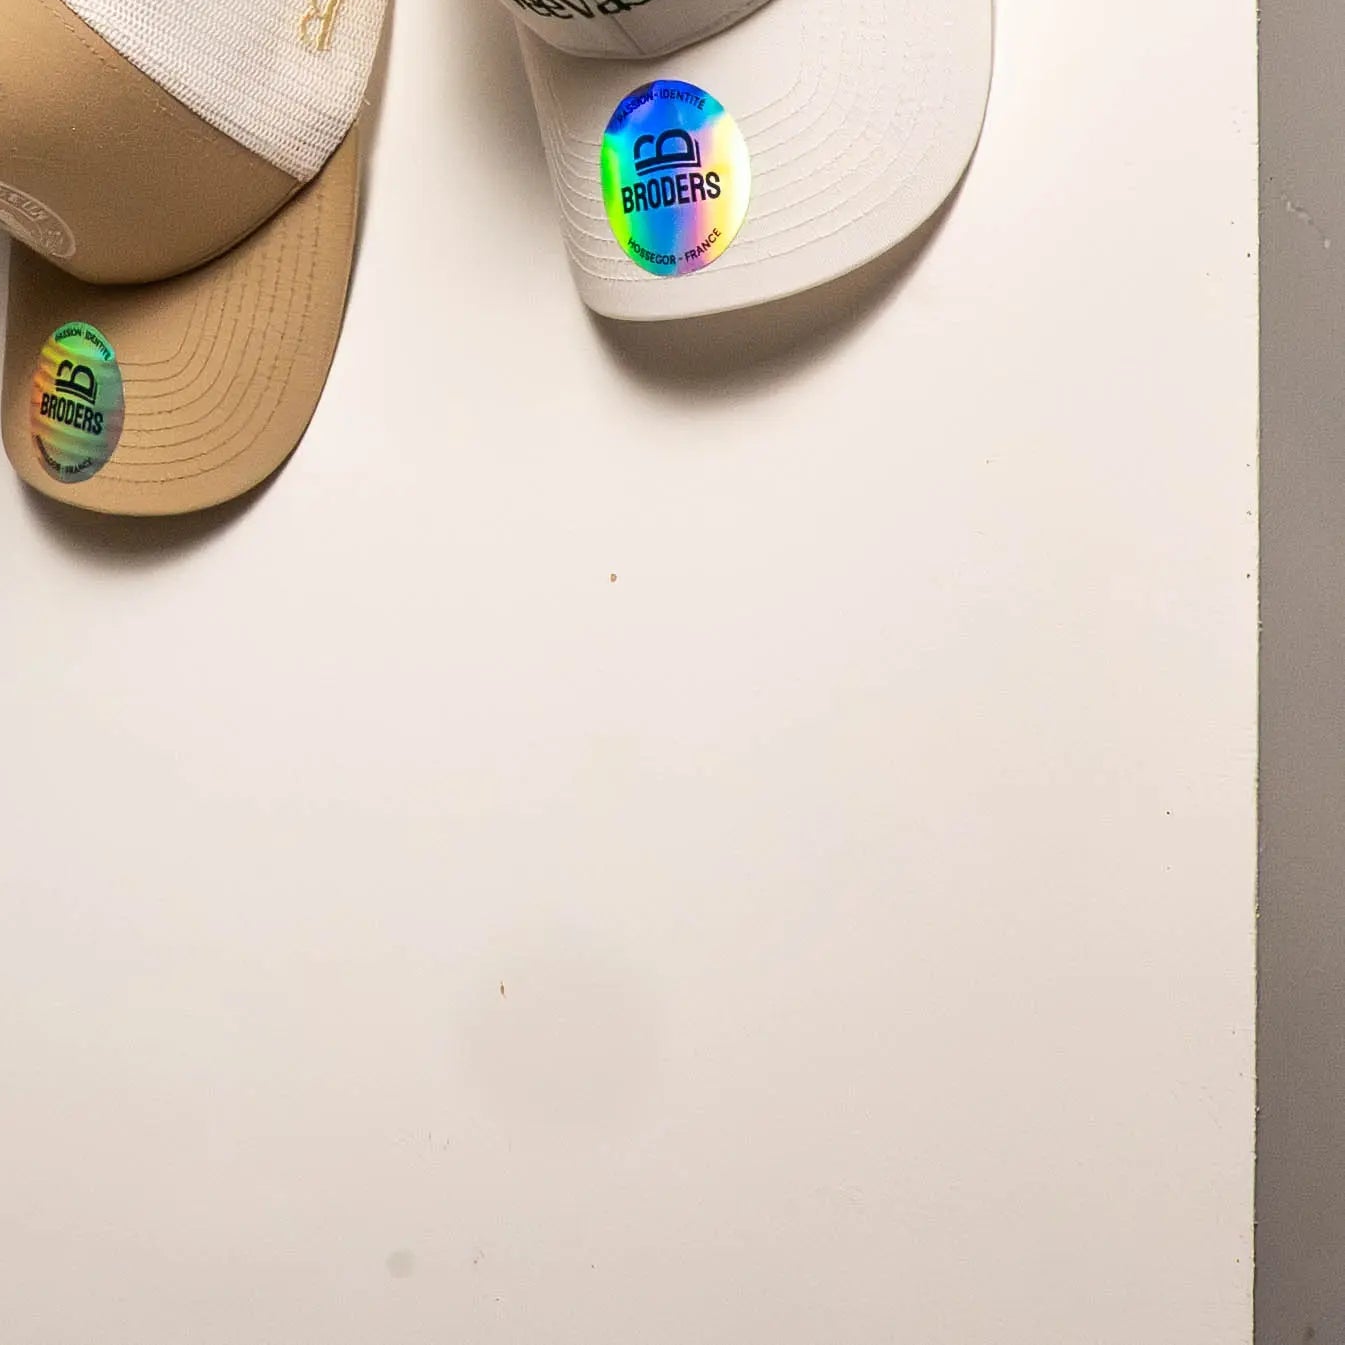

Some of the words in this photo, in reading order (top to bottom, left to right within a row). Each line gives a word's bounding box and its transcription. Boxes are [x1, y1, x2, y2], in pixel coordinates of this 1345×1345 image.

[621, 171, 721, 214] BRODERS
[627, 237, 676, 265] HOSSEGOR
[684, 227, 722, 263] FRANCE
[40, 392, 104, 435] BRODERS
